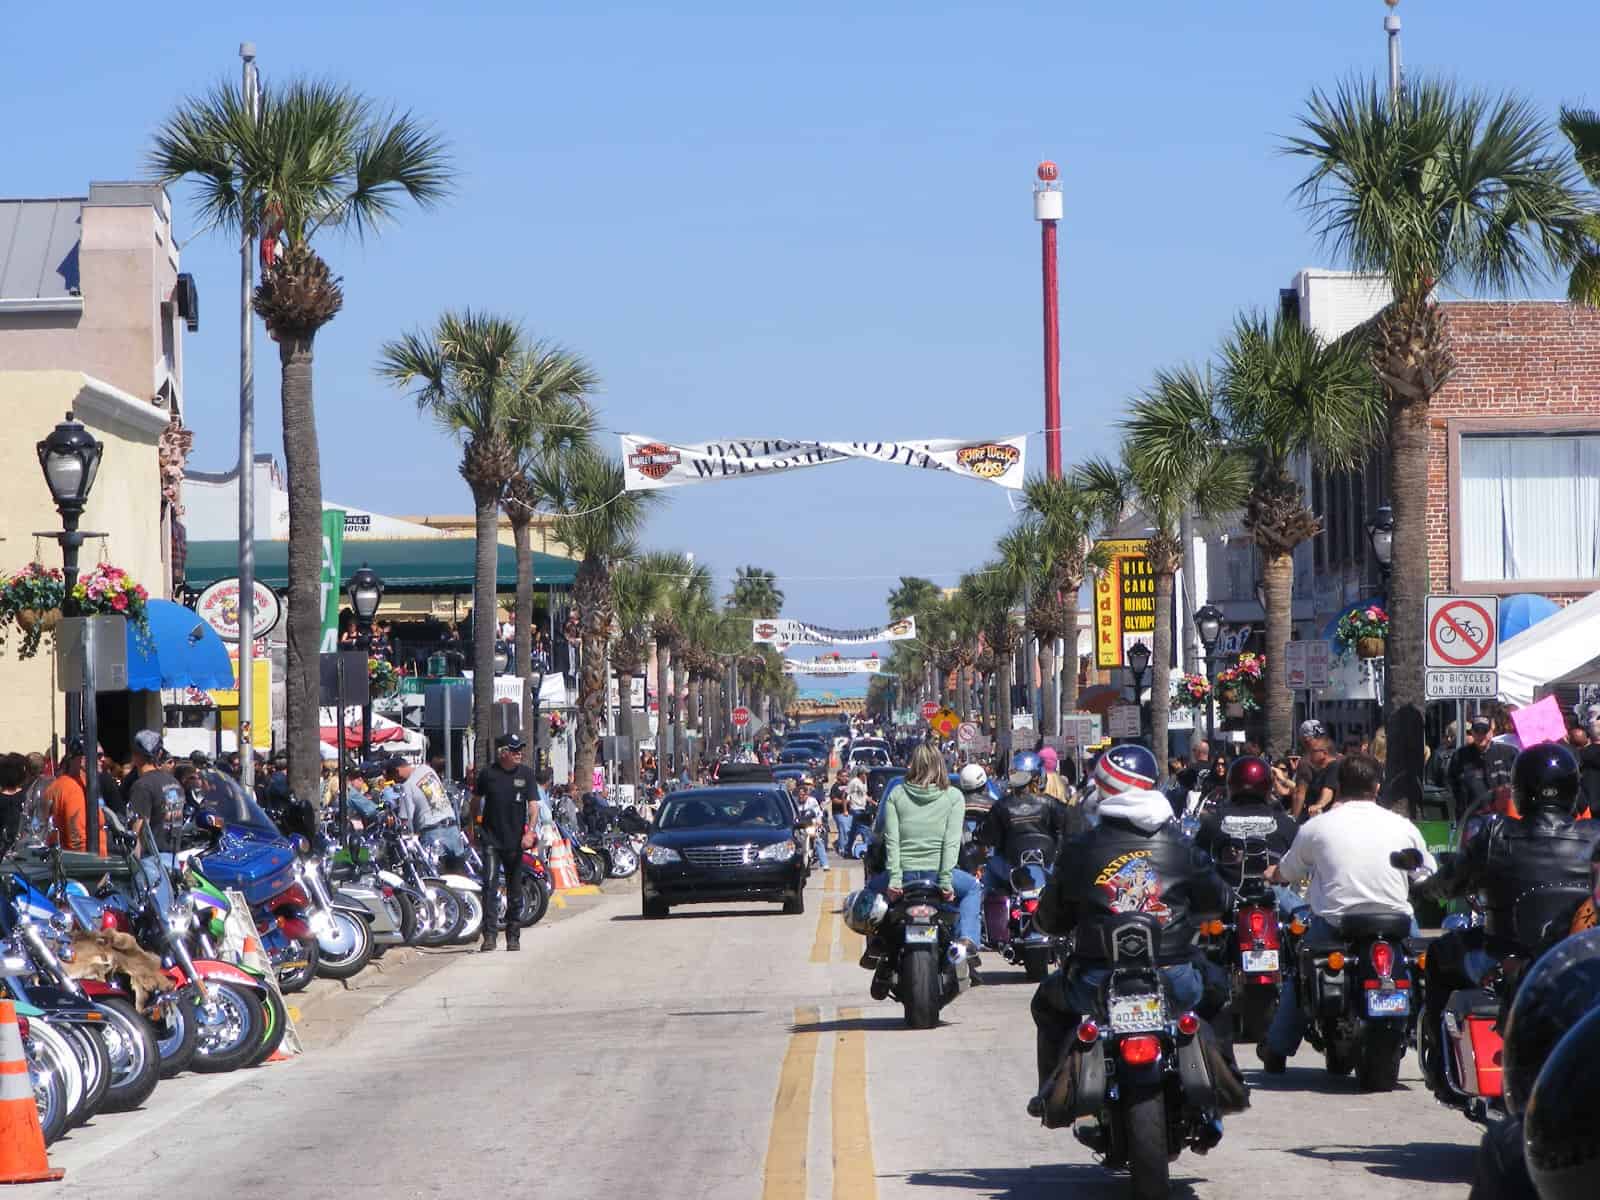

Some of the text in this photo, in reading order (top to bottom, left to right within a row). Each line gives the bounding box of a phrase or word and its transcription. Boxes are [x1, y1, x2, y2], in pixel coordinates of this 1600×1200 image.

[1124, 580, 1155, 593] CANO
[1124, 598, 1155, 611] MINOLT
[1100, 582, 1112, 644] odak
[1125, 616, 1155, 630] OLYMP
[1433, 673, 1490, 682] NO BICYCLES
[1433, 685, 1490, 694] ON SIDEWALK
